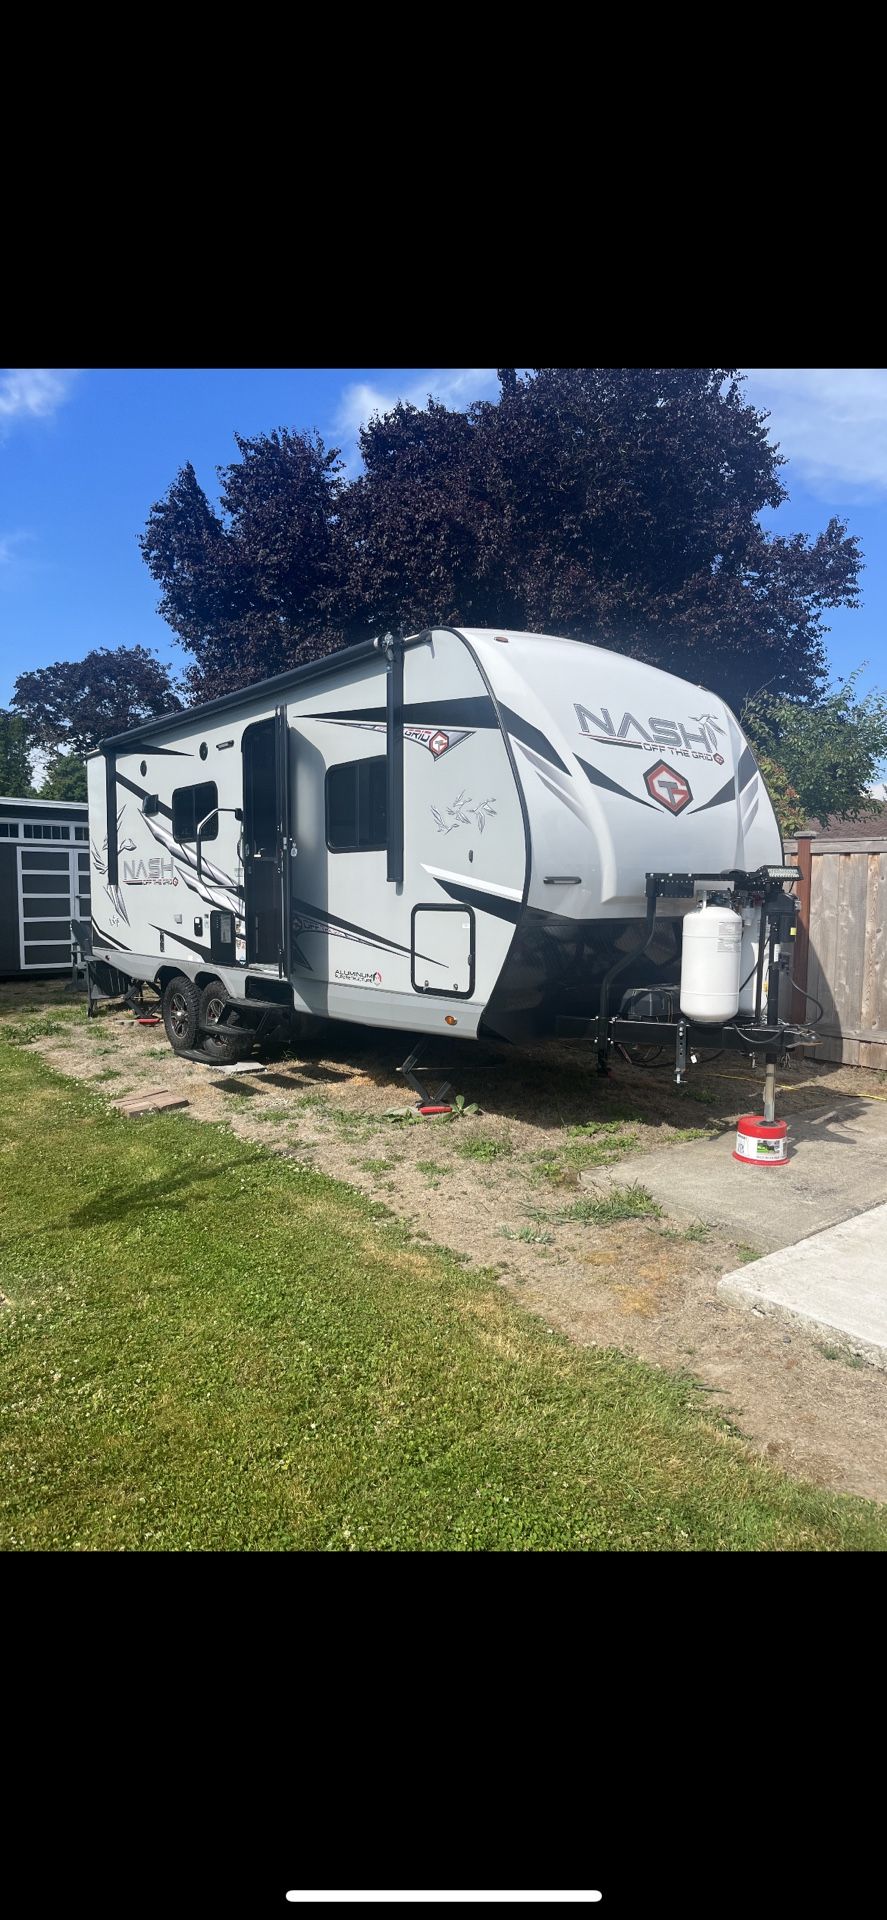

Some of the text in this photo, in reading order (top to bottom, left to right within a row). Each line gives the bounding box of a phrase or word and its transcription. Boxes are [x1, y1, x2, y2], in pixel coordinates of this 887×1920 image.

[573, 703, 713, 753] NASH
[643, 742, 713, 761] OFF THE GRID
[123, 857, 174, 880] NASH
[335, 969, 373, 979] ALUMINUM
